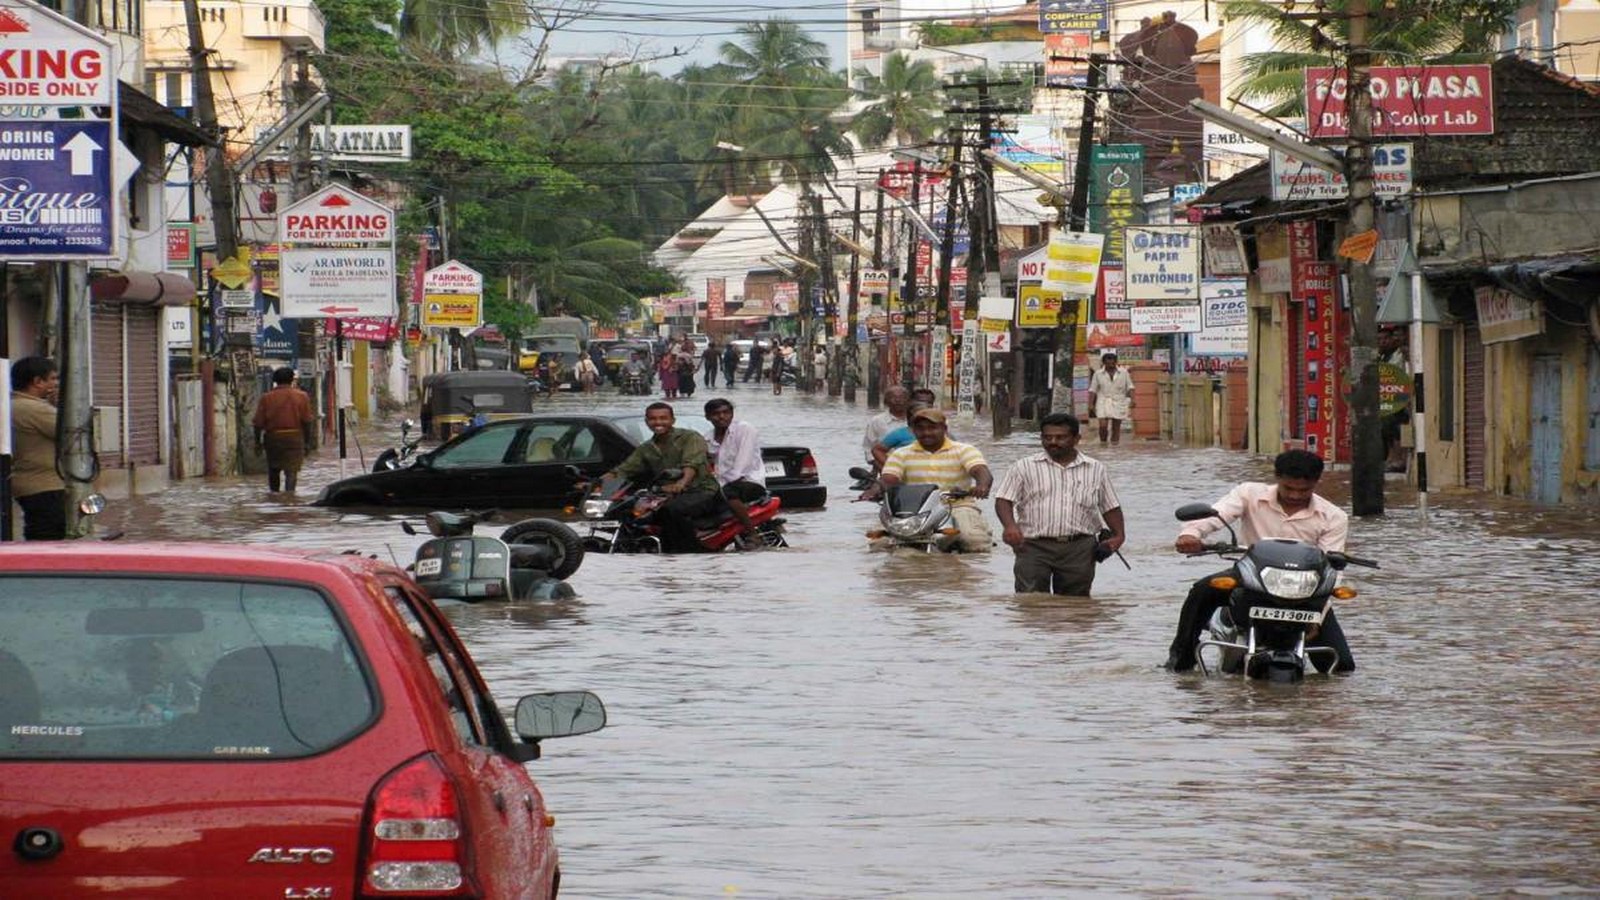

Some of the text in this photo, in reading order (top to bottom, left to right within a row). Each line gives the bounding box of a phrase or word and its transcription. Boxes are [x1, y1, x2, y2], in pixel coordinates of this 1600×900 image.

[1060, 21, 1098, 29] CAREER
[0, 82, 99, 97] SIDE ONLY
[1315, 75, 1483, 101] FOO PLASA
[1444, 110, 1479, 126] Lab
[1319, 185, 1339, 195] Trip
[286, 215, 388, 230] PARKING
[47, 226, 63, 235] for
[287, 231, 386, 239] FOR LEFT SIDE ONLY
[29, 236, 58, 246] Phone
[1144, 252, 1179, 262] PAPER
[313, 257, 385, 268] ARABWORLD
[1022, 263, 1038, 276] NO
[1158, 264, 1167, 273] &
[432, 273, 474, 282] PARKING
[1131, 273, 1194, 284] STATIONERS
[11, 725, 84, 737] HERCULES
[240, 745, 271, 754] PARK
[248, 848, 334, 864] ALTO
